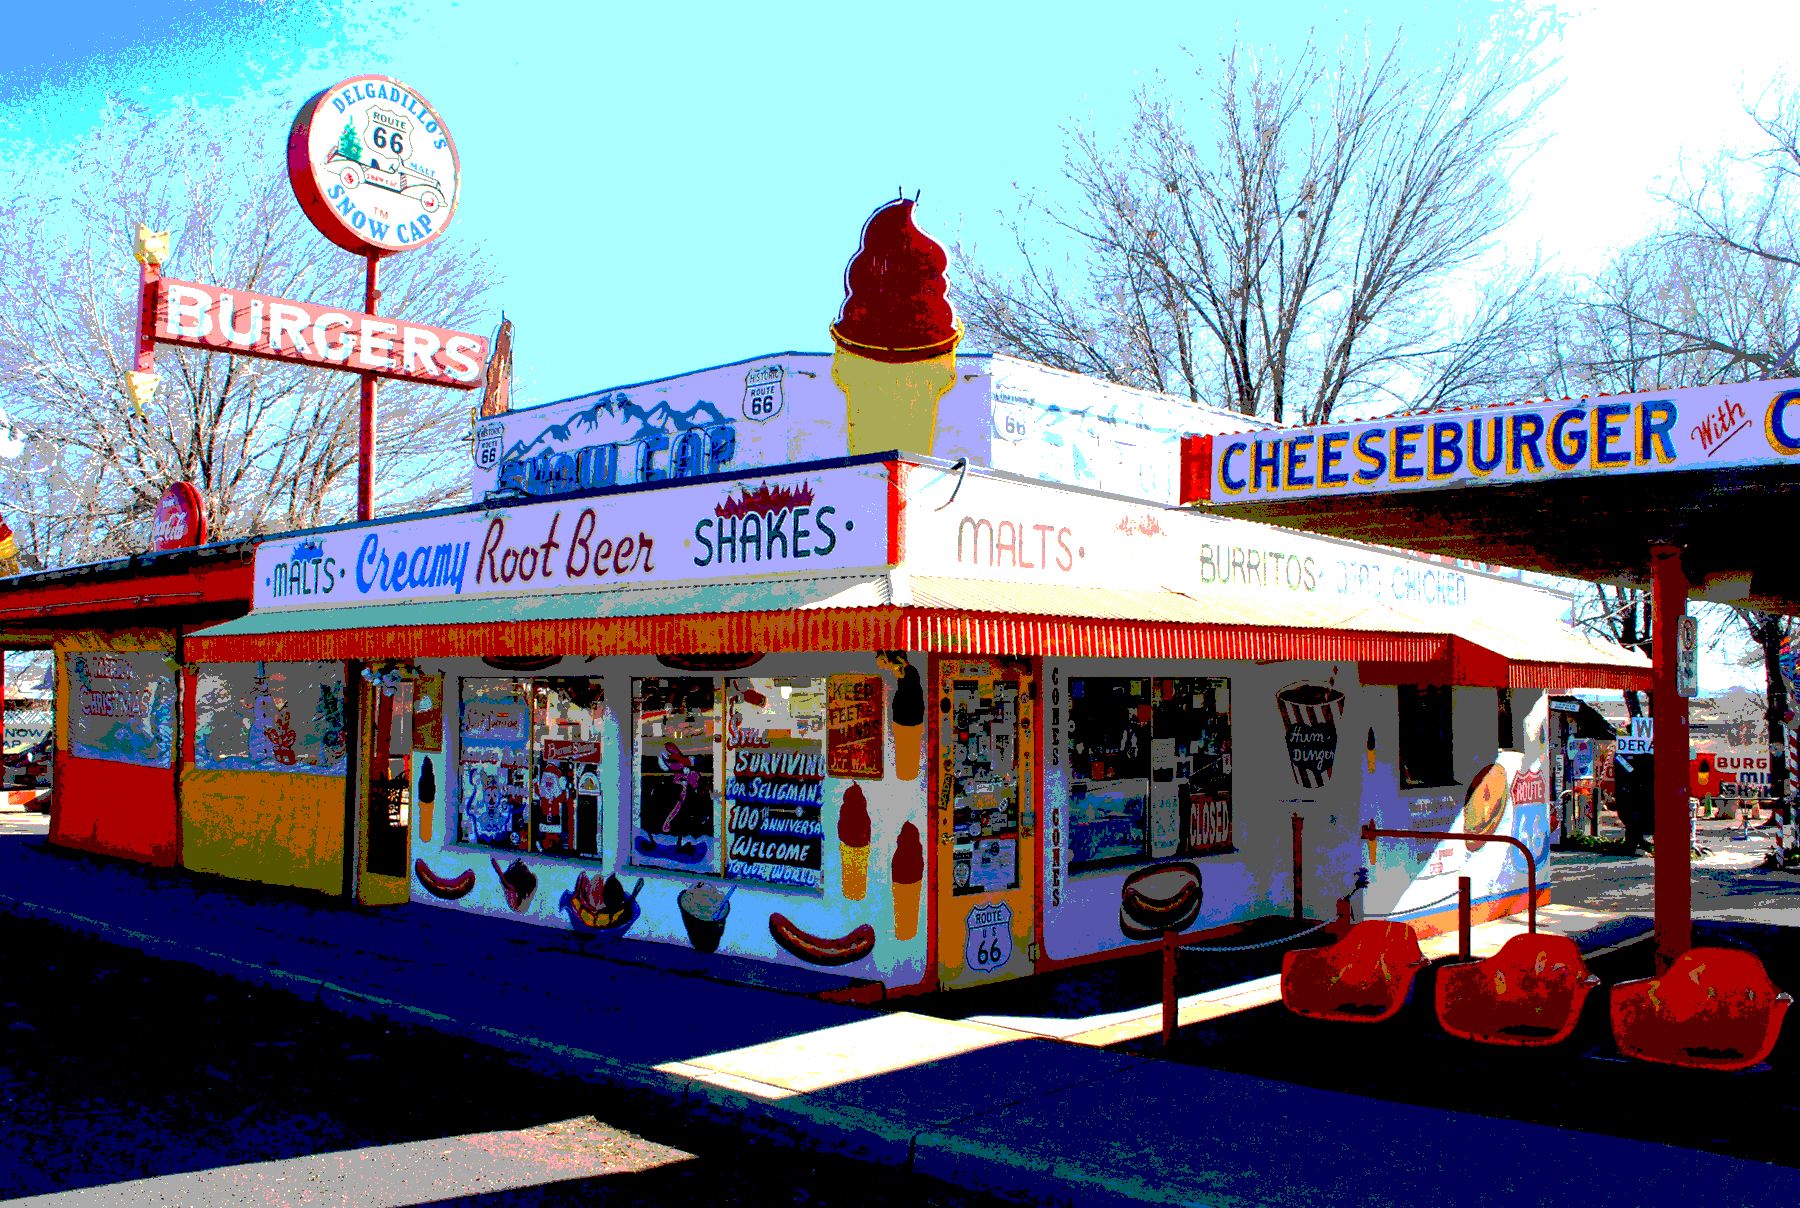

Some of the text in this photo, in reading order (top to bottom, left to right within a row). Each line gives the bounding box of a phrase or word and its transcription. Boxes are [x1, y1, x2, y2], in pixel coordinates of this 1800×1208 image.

[331, 82, 448, 150] DELGADILLO'S
[373, 111, 407, 130] ROUTE
[373, 127, 404, 155] 66
[327, 184, 433, 243] SNOW CAP
[166, 284, 481, 382] BURGERS
[751, 386, 775, 396] ROUTE
[752, 395, 773, 415] 66
[482, 448, 497, 464] 66
[1219, 400, 1678, 495] CHEESEBURGER
[1691, 399, 1746, 450] With
[273, 505, 836, 597] MALTS Creamy Root Beer SHAKES
[957, 516, 1075, 571] MALTS
[1200, 543, 1316, 592] BURRITOS
[1051, 667, 1061, 767] CONES
[3, 740, 22, 749] AP
[4, 727, 45, 738] NOW
[1717, 757, 1768, 770] BURG
[1516, 779, 1543, 802] ROUTE
[1189, 800, 1230, 847] CLOSED
[1518, 812, 1546, 857] 66
[732, 836, 810, 861] WELCOME
[975, 910, 1002, 924] ROUTE
[977, 937, 1002, 965] 66
